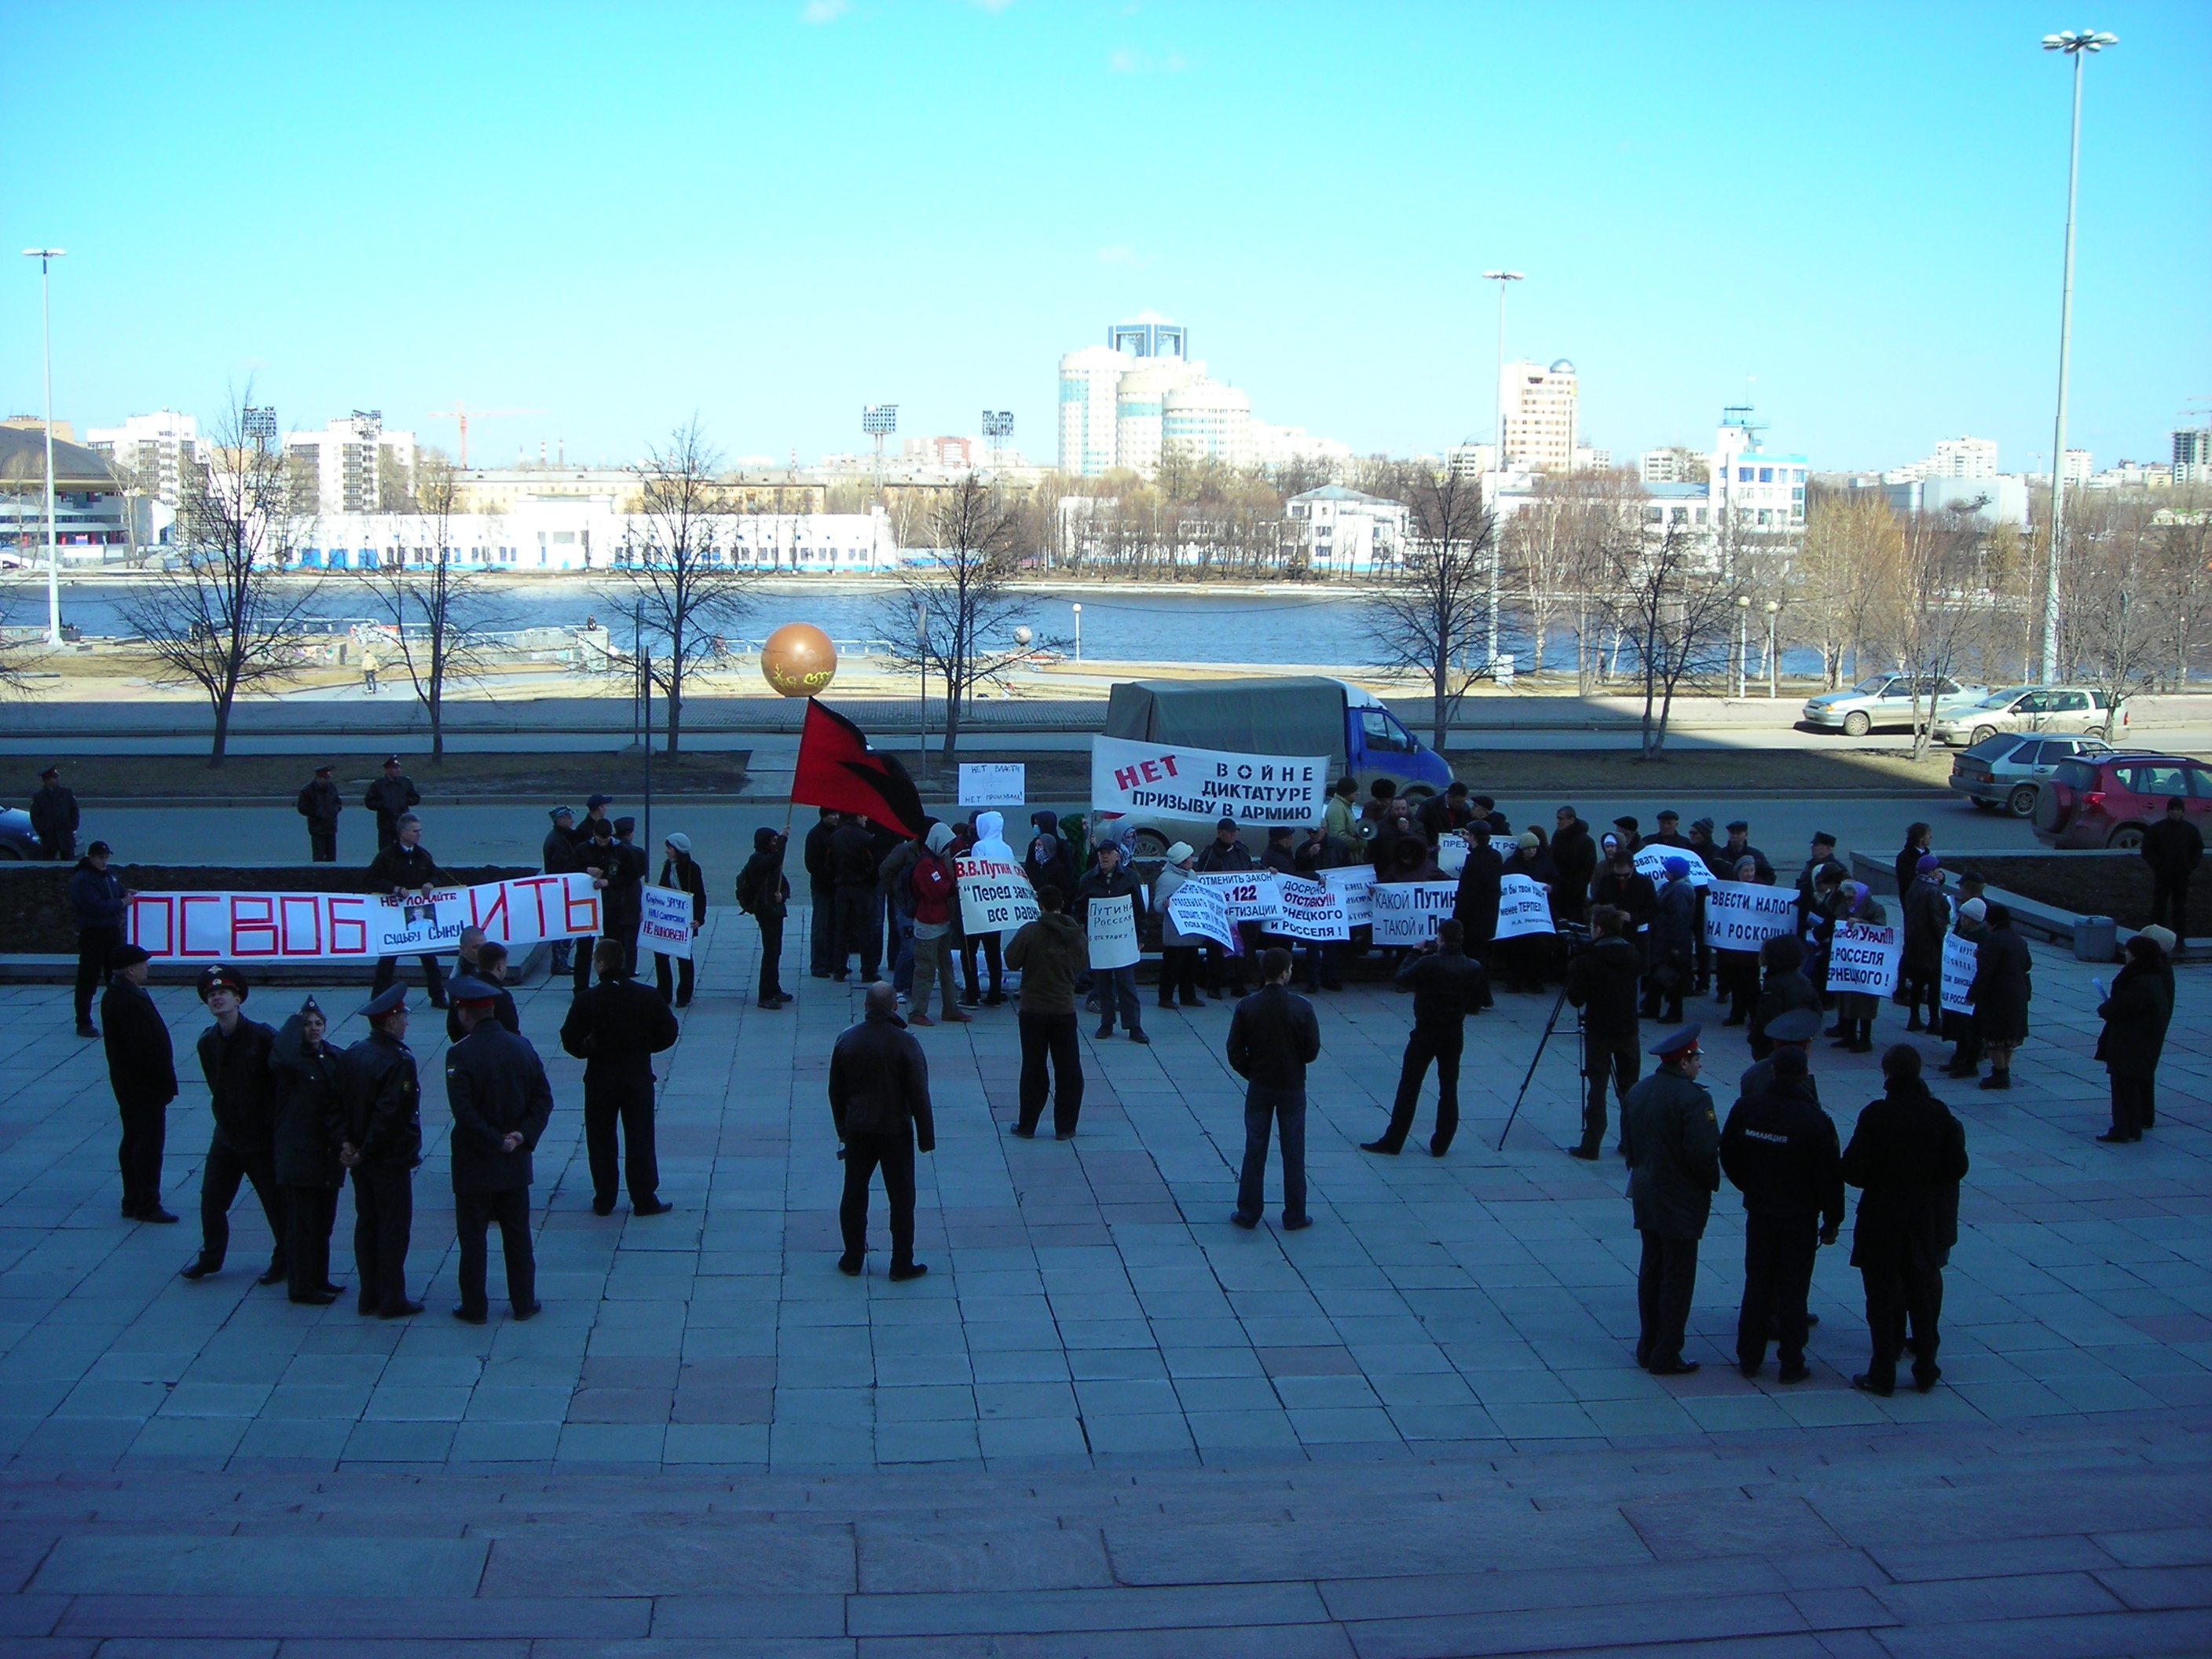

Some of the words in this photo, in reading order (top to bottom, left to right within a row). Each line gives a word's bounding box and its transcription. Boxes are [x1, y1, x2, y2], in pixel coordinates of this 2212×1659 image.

[1114, 755, 1179, 791] НЕТ
[1217, 763, 1313, 782] ВОЙНЕ
[1202, 780, 1312, 801] ДИКТАТУРЕ
[1132, 790, 1216, 815] ПРИЗЫВУ
[1222, 803, 1233, 817] В
[1240, 806, 1312, 820] АРМИЮ
[1199, 874, 1244, 885] ОТМЕНИТЬ
[1246, 873, 1273, 882] ЗАКОН
[380, 896, 398, 906] НЕ
[1232, 884, 1257, 901] 122
[1375, 890, 1410, 910] КАКОЙ
[1712, 891, 1750, 910] ВВЕСТИ
[1756, 897, 1794, 914] НАЛОГ
[987, 907, 1009, 923] все
[383, 931, 421, 945] СУДЬБУ
[428, 920, 465, 940] СЫНУ!
[1283, 921, 1335, 937] РОССЕЛЯ
[1382, 917, 1415, 936] ТАКОЙ
[1707, 921, 1720, 936] НА
[1728, 923, 1784, 941] РОСКОШ
[1835, 947, 1884, 965] РОССЕЛЯ
[1745, 1129, 1788, 1144] МИЛИЦИЯ
